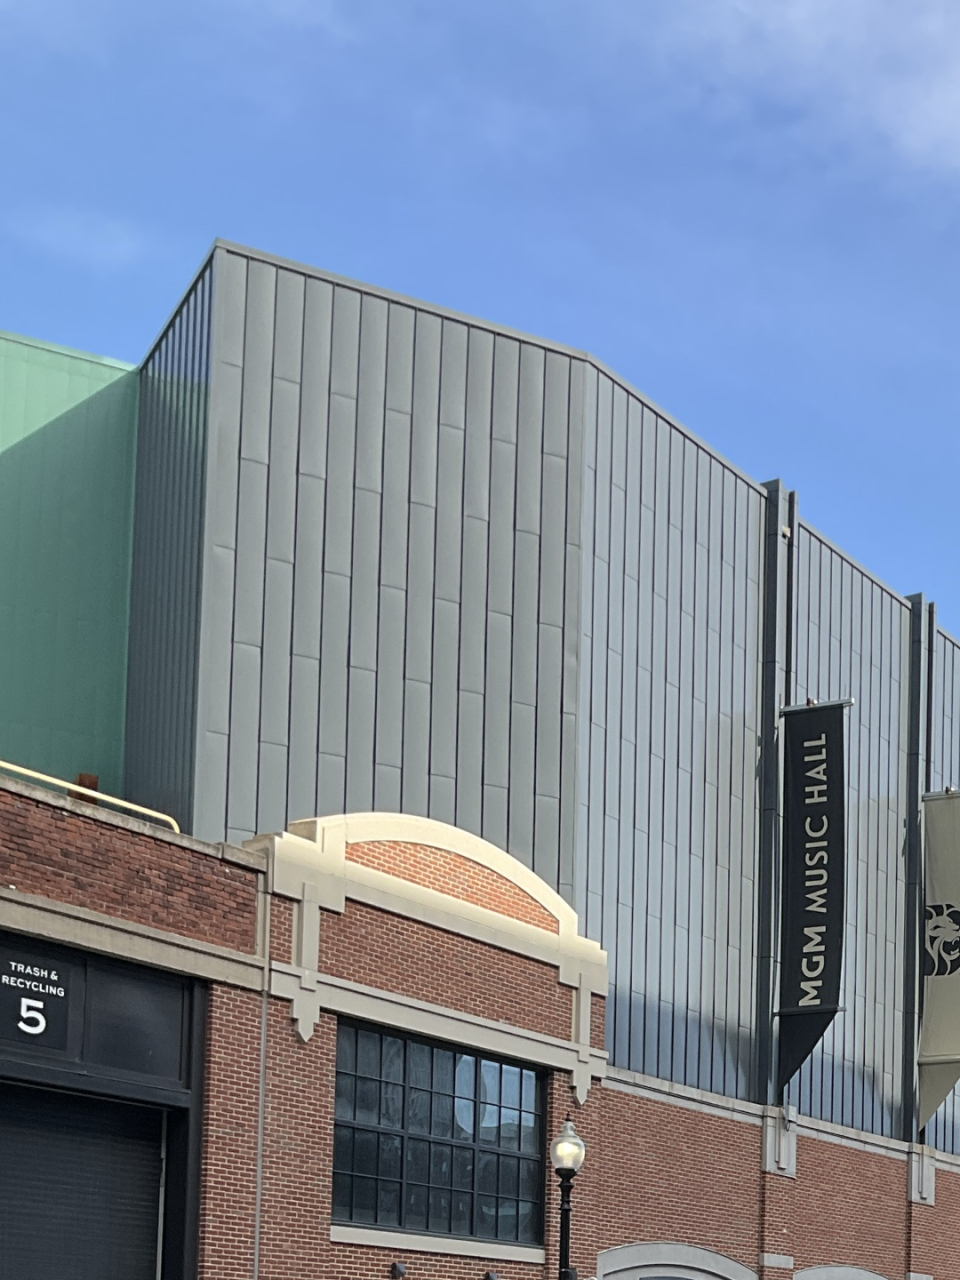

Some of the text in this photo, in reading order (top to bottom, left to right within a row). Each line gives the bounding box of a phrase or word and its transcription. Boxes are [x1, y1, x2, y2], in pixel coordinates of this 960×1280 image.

[799, 733, 829, 1007] MGM MUSIC HALL
[1, 975, 65, 997] RECYCLING
[9, 961, 59, 981] TRASH &
[17, 997, 47, 1035] 5
